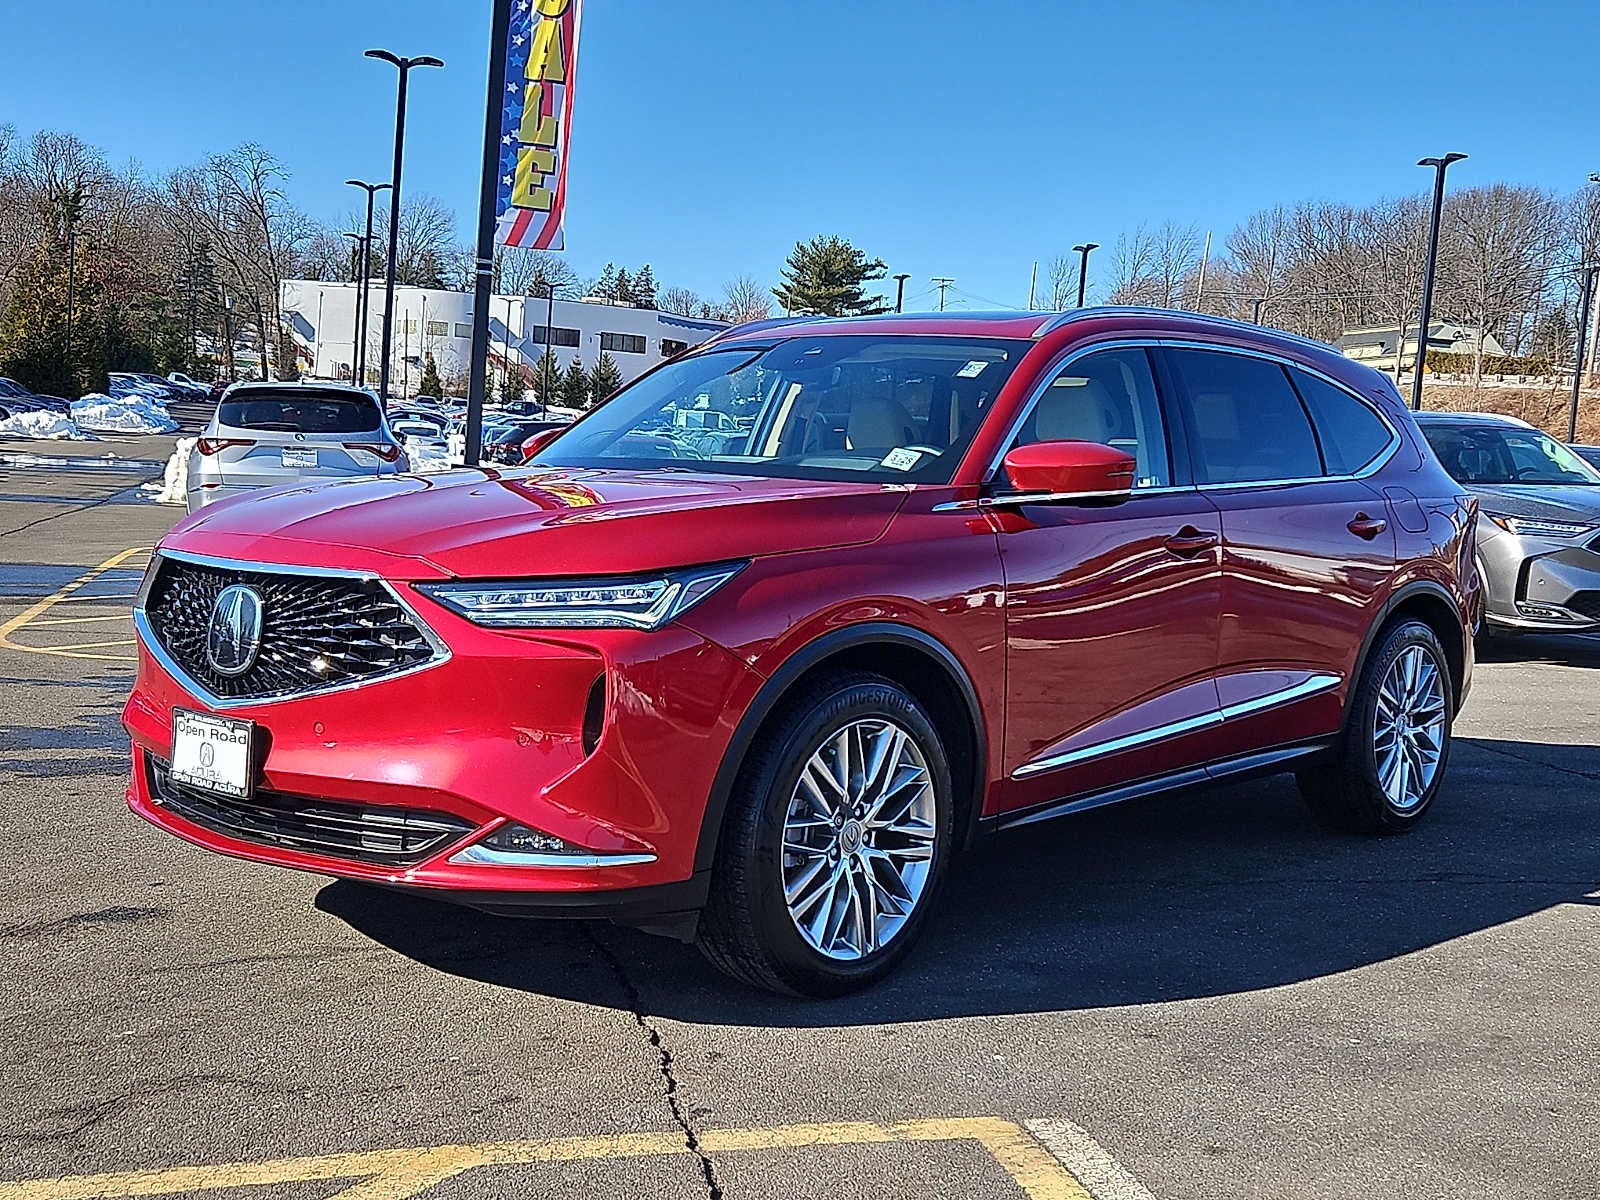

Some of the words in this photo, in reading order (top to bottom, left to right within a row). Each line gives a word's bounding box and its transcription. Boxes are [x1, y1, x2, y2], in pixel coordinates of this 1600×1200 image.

[511, 0, 570, 211] ALE
[178, 721, 205, 738] Open
[210, 728, 247, 745] Road
[172, 771, 191, 784] OPEN
[191, 776, 213, 789] ROAD
[213, 783, 242, 796] ACURA
